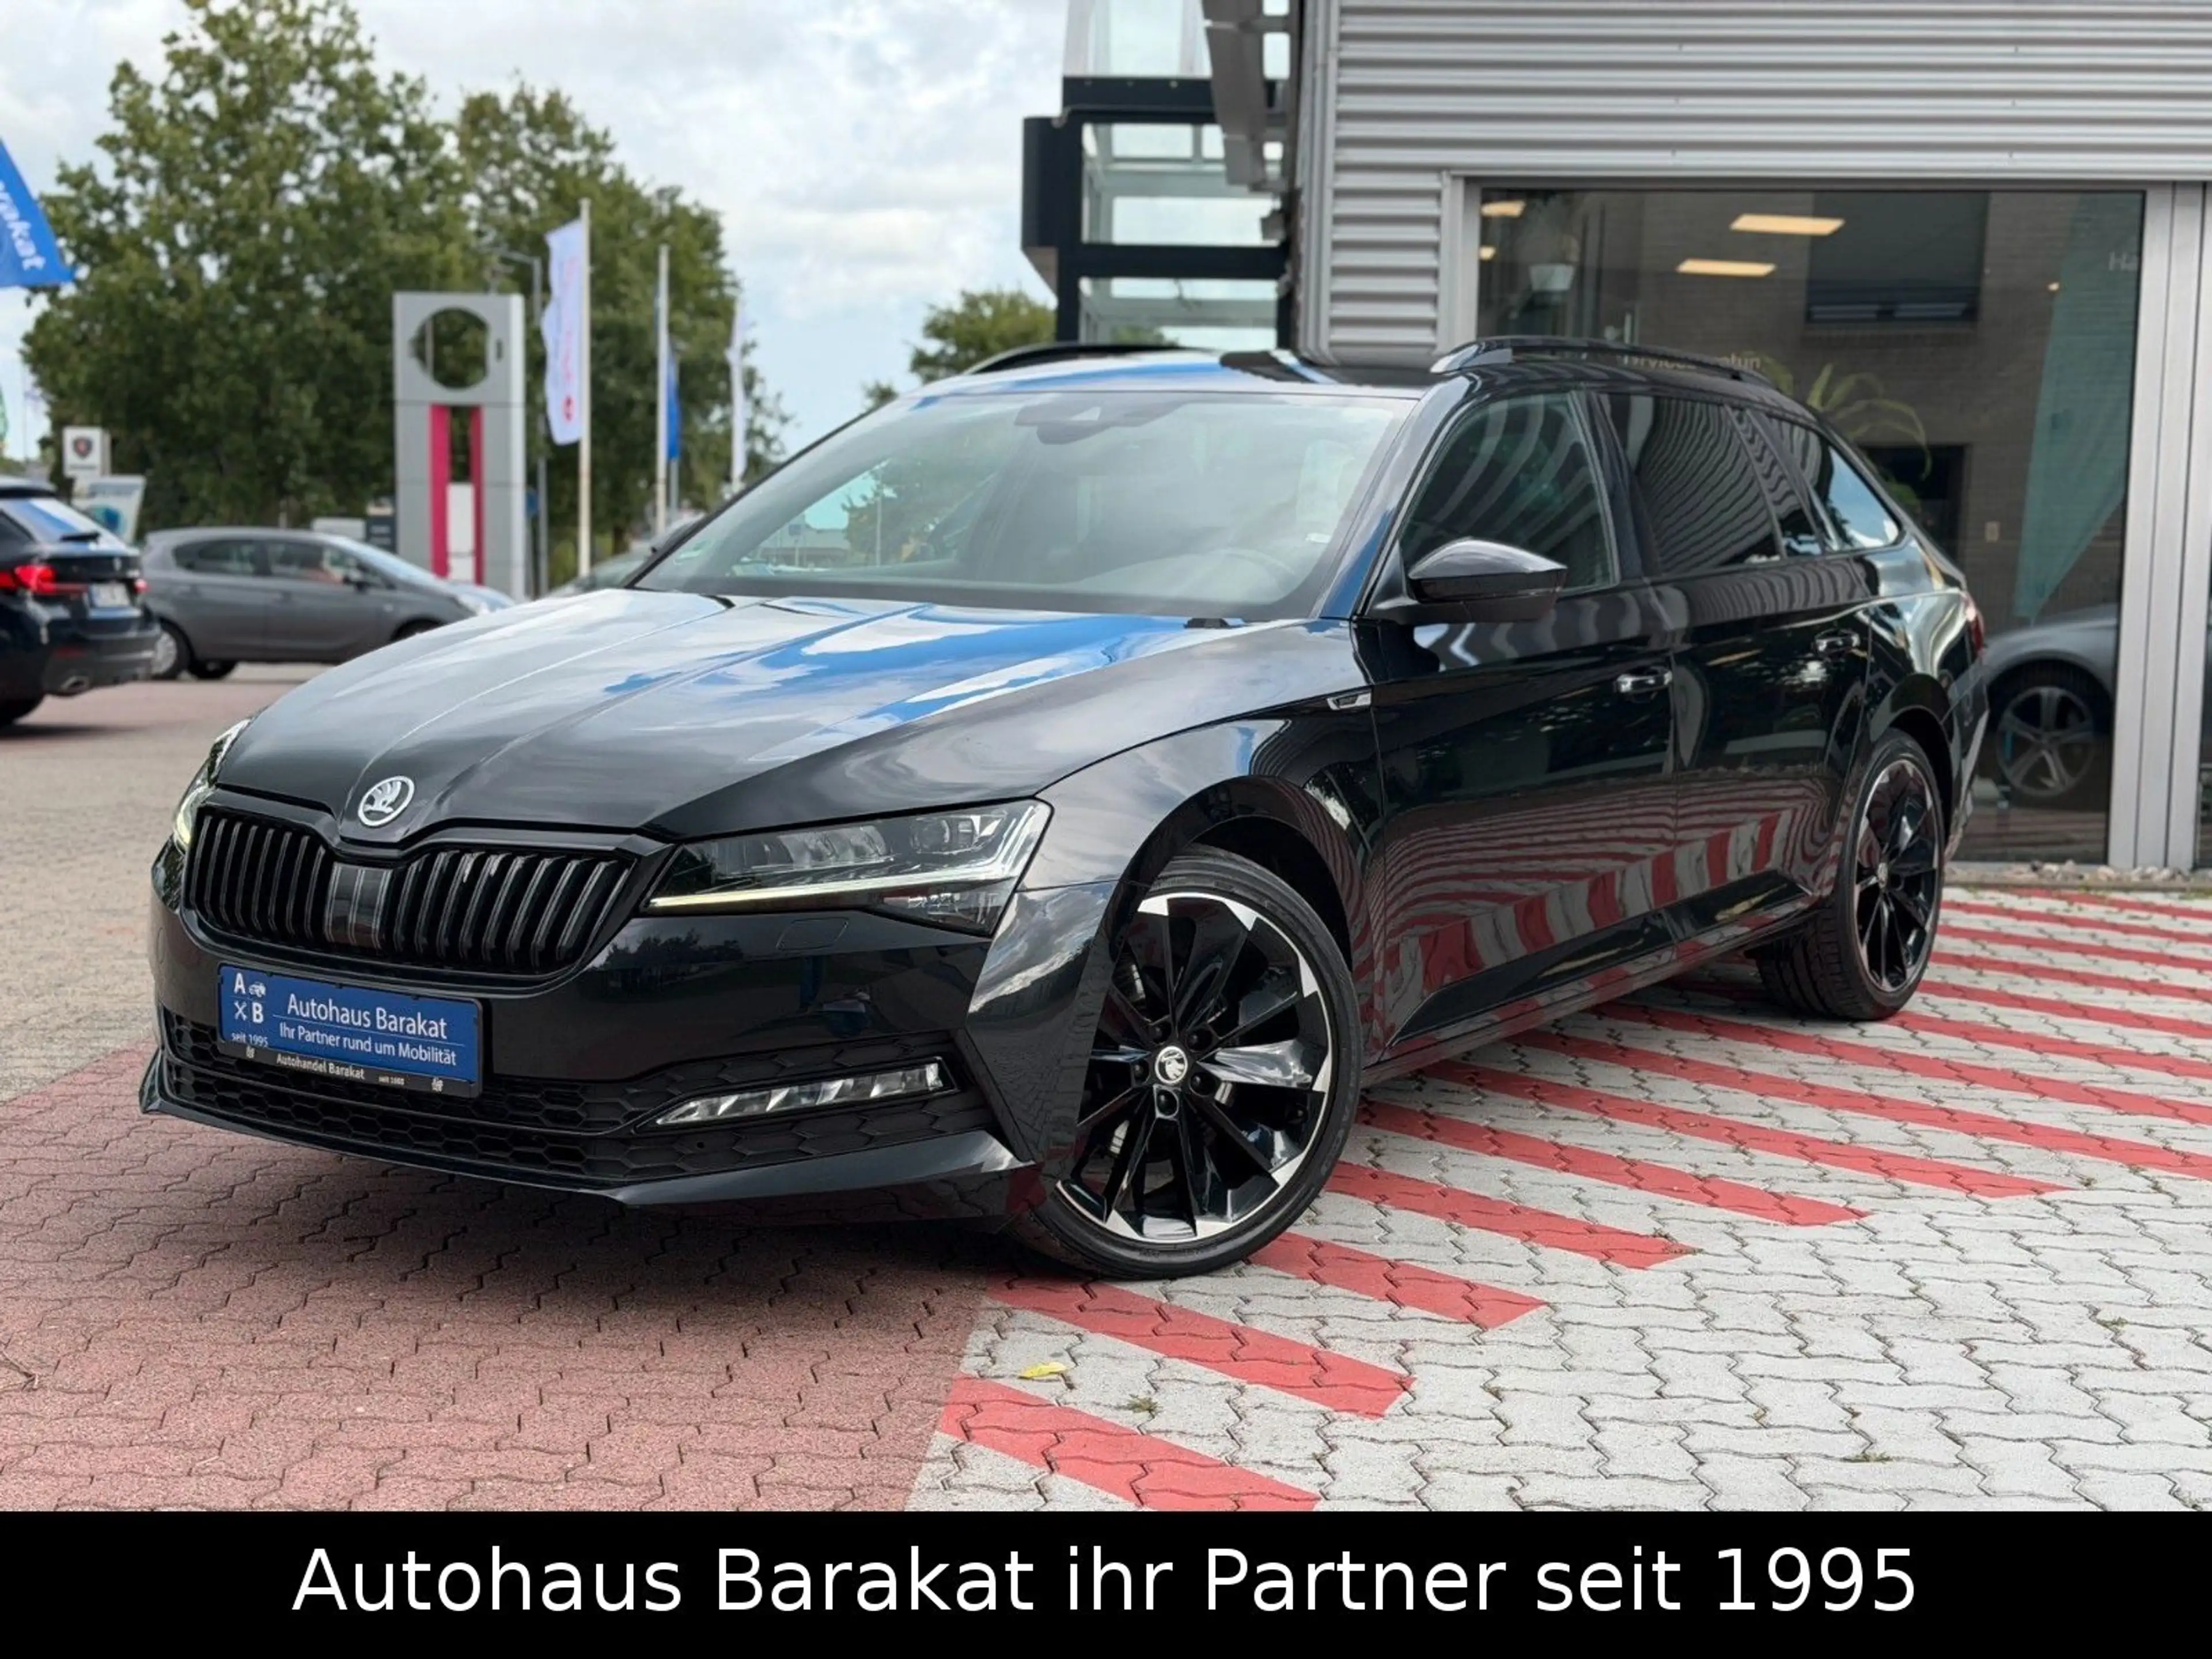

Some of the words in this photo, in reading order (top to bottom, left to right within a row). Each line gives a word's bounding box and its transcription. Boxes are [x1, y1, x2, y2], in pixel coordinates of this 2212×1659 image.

[0, 180, 46, 271] rakat
[287, 993, 372, 1028] Autohaus
[376, 1006, 448, 1039] Barakat
[232, 1031, 245, 1043] seit
[248, 1033, 268, 1048] 1995
[279, 1021, 295, 1039] Ihr
[298, 1025, 339, 1047] Partner
[342, 1035, 372, 1052] rund
[374, 1041, 395, 1056] um
[398, 1041, 457, 1066] Mobilität
[276, 1052, 327, 1073] Autohandel
[328, 1063, 365, 1080] Barakat
